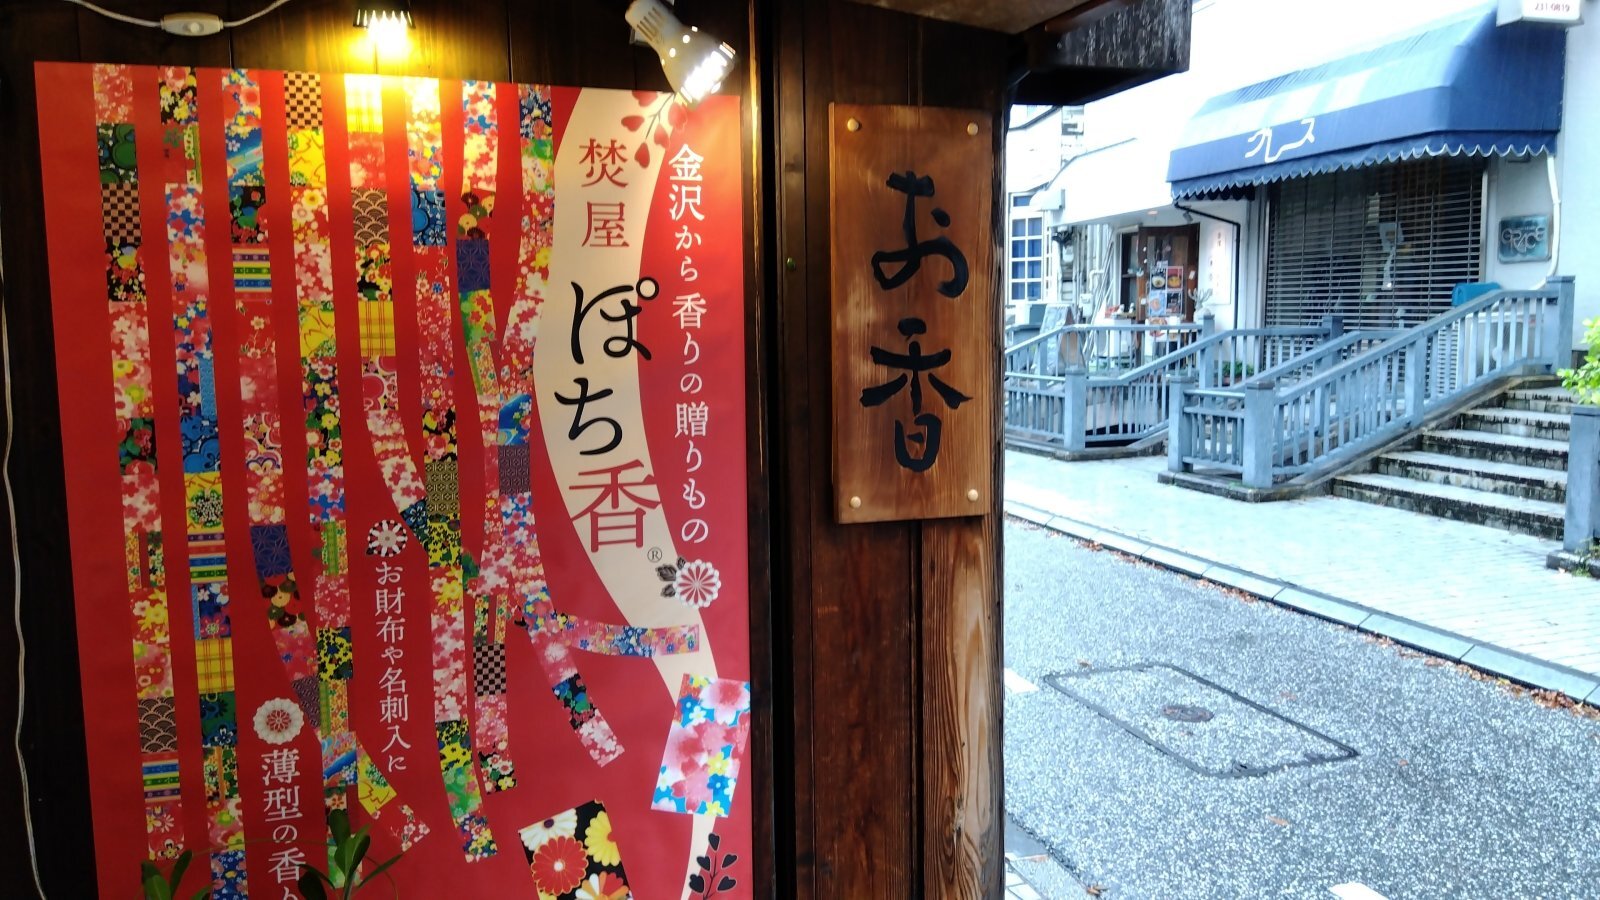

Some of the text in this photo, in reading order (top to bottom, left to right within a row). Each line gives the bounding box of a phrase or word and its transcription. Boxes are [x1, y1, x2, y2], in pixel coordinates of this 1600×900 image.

[578, 137, 630, 248] 焚屋
[860, 170, 973, 473] お香
[554, 276, 662, 554] ぽち香
[668, 143, 709, 544] 金沢から香りの贈りもの
[375, 561, 411, 773] お財布や名刺入に
